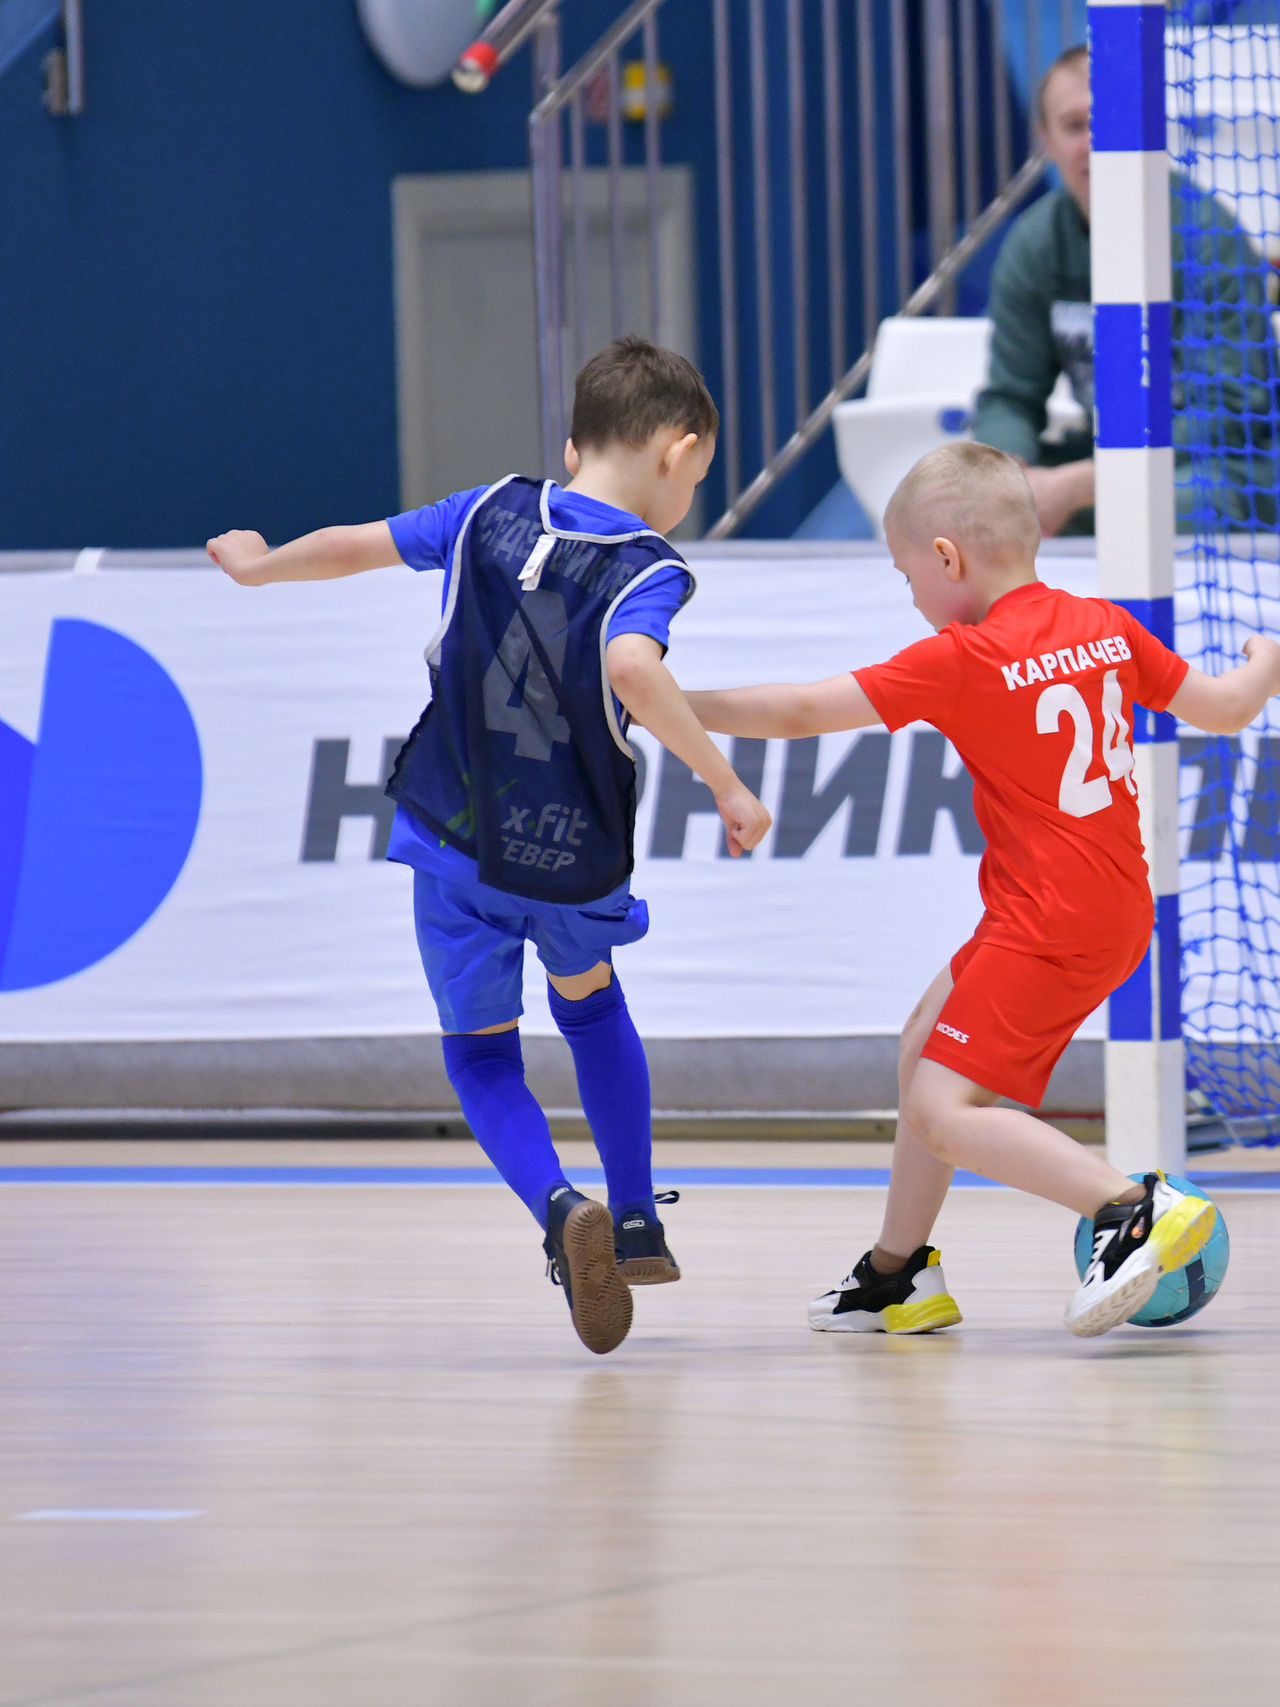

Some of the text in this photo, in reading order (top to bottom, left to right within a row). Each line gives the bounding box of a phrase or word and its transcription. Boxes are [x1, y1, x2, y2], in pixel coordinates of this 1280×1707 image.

[482, 588, 571, 762] 4
[1000, 635, 1133, 691] КАРПАЧЕВ
[1035, 668, 1138, 818] 24
[500, 836, 576, 872] ЕВЕР
